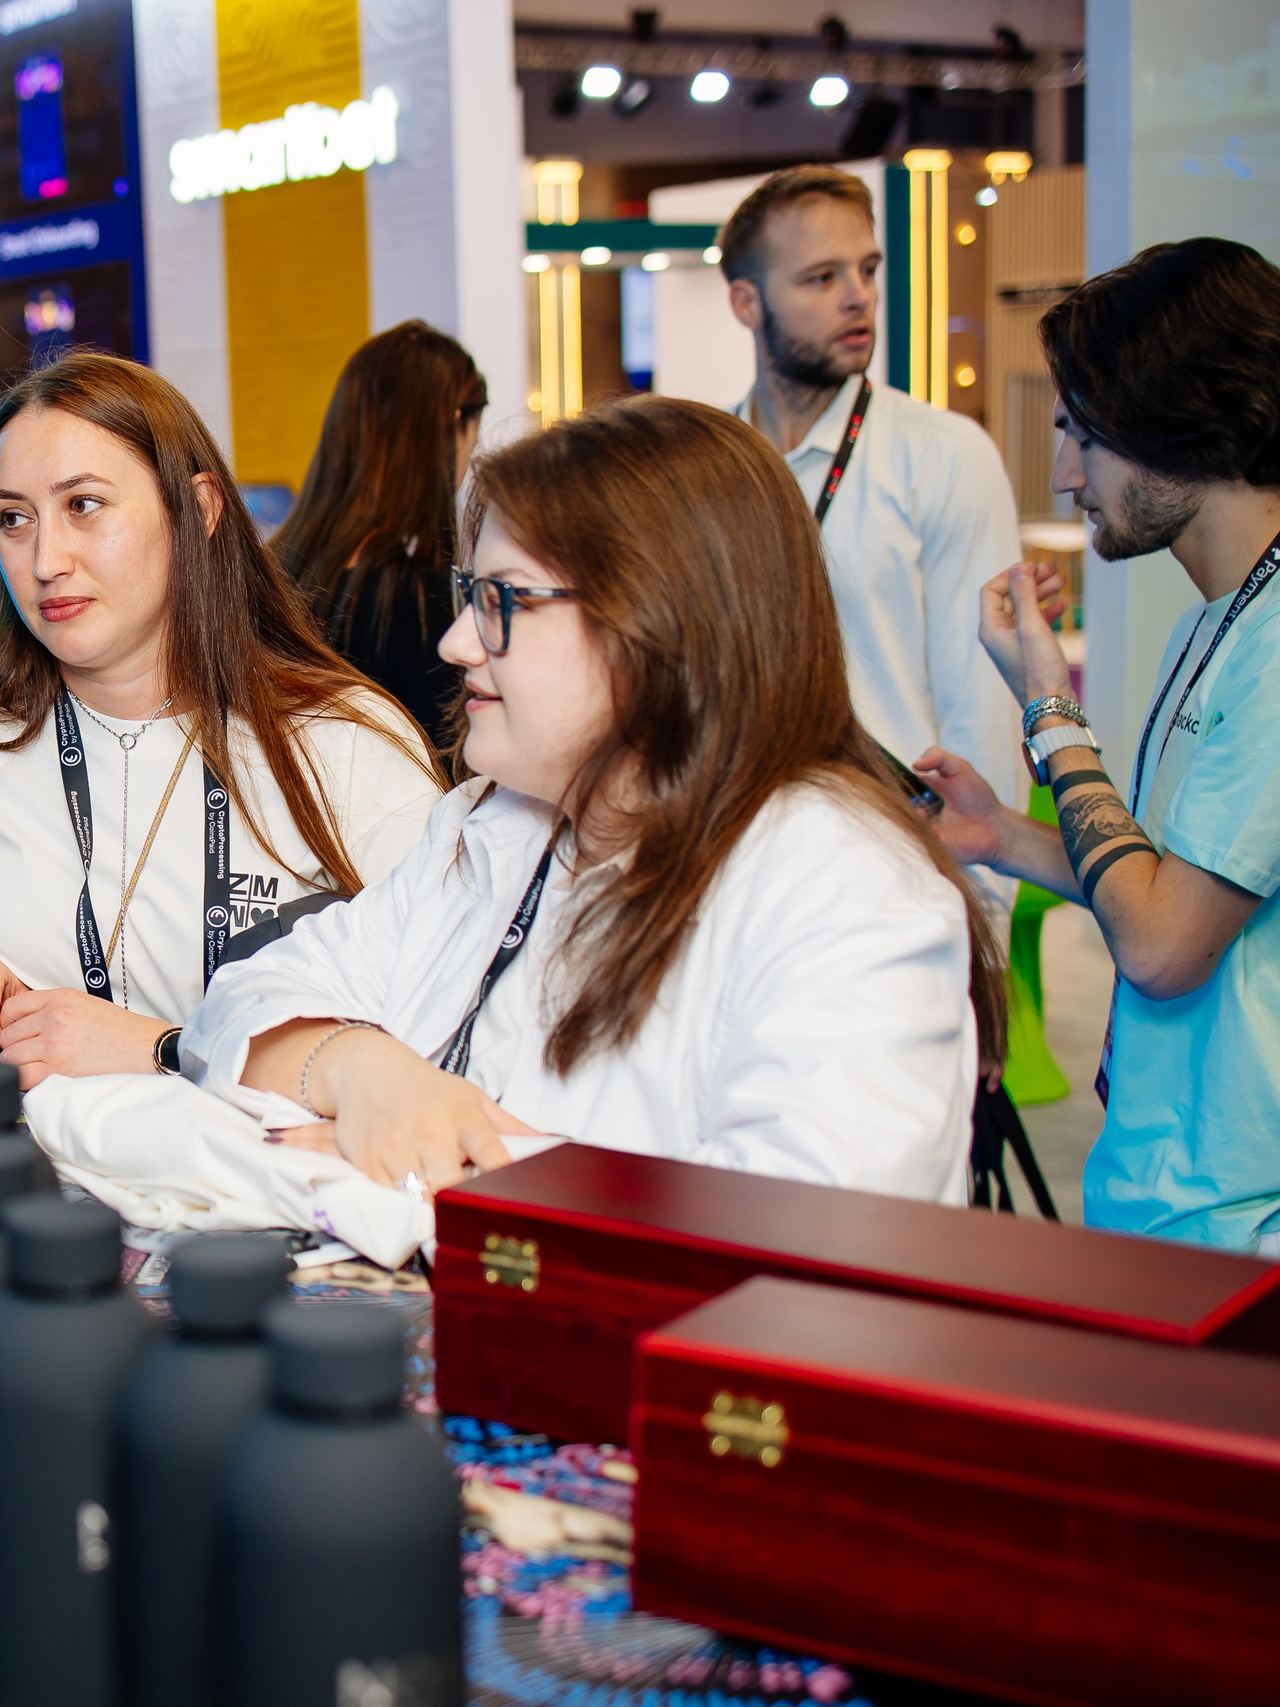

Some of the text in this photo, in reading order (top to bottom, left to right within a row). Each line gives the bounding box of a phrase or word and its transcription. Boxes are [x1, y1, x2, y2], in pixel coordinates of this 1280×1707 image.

[1228, 559, 1277, 621] Payment
[70, 790, 87, 857] CryptoProcessing
[217, 810, 226, 879] CryptoProcessing
[87, 919, 99, 955] CoinsPaid
